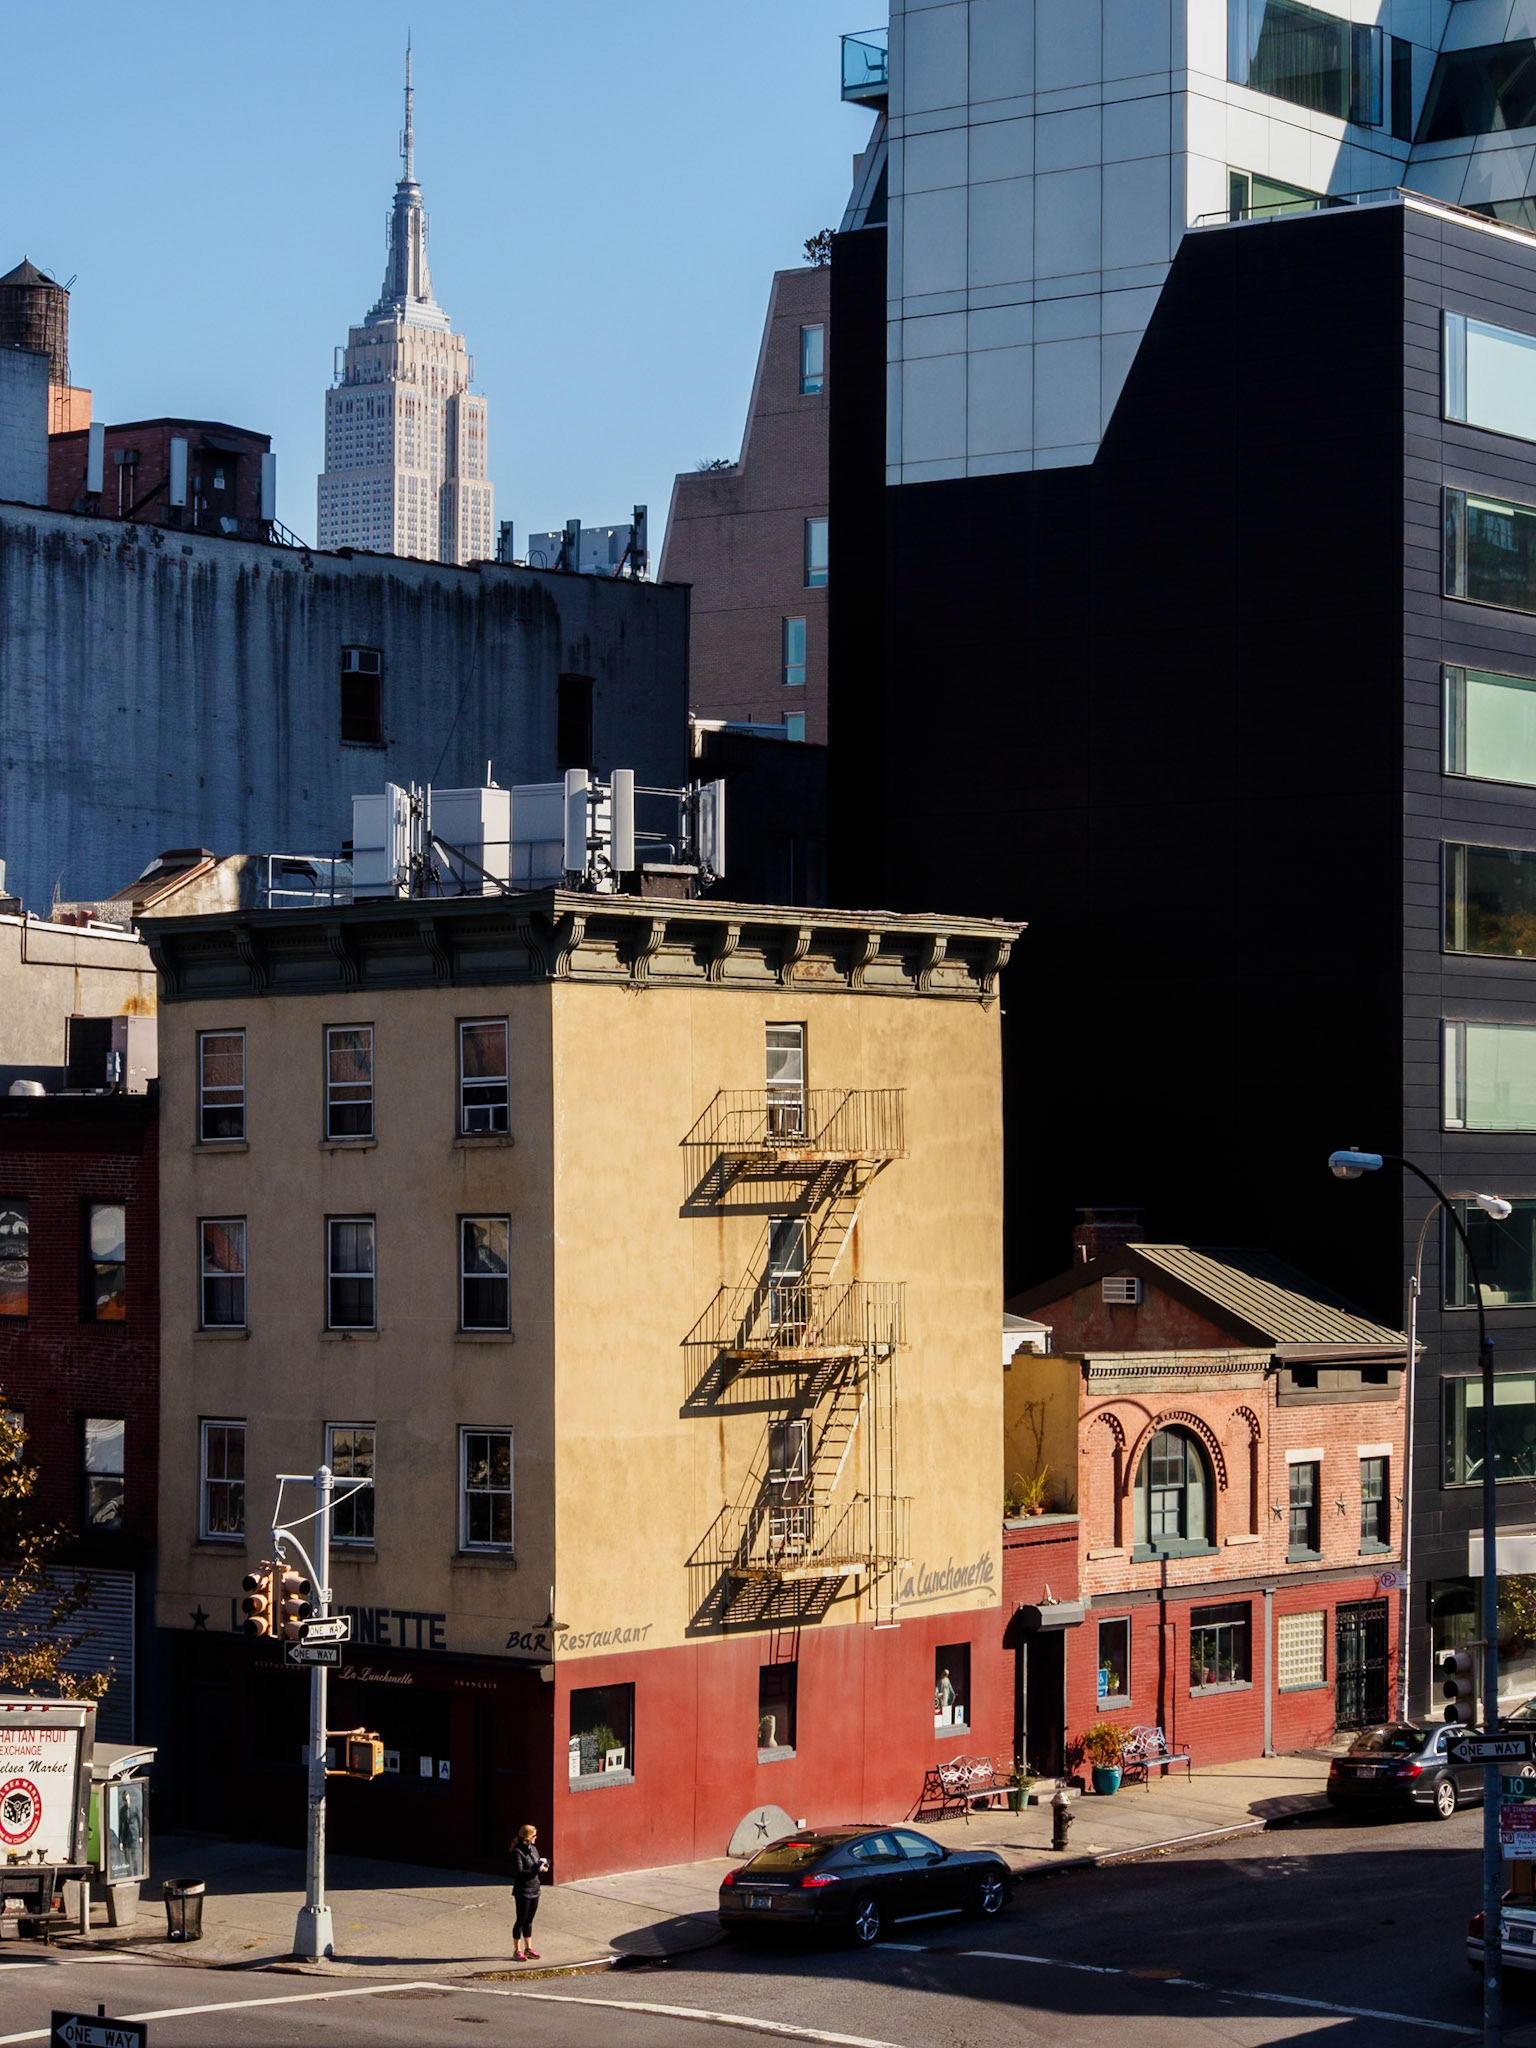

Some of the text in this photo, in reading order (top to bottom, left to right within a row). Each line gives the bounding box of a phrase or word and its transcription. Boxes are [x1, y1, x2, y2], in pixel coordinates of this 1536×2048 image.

[917, 1551, 994, 1597] Lunchonette
[309, 1624, 343, 1636] ONE WAY
[294, 1648, 334, 1659] ONE WAY
[39, 1730, 67, 1743] FRUIT
[0, 1745, 42, 1756] EXCHANGE
[1460, 1743, 1520, 1756] ONE WAY
[0, 1760, 68, 1774] elsea Market
[441, 1762, 449, 1774] A
[1508, 1778, 1525, 1795] 10
[22, 1780, 41, 1816] MARKET
[1502, 1833, 1514, 1843] NO
[65, 2025, 134, 2048] ONE WAY
